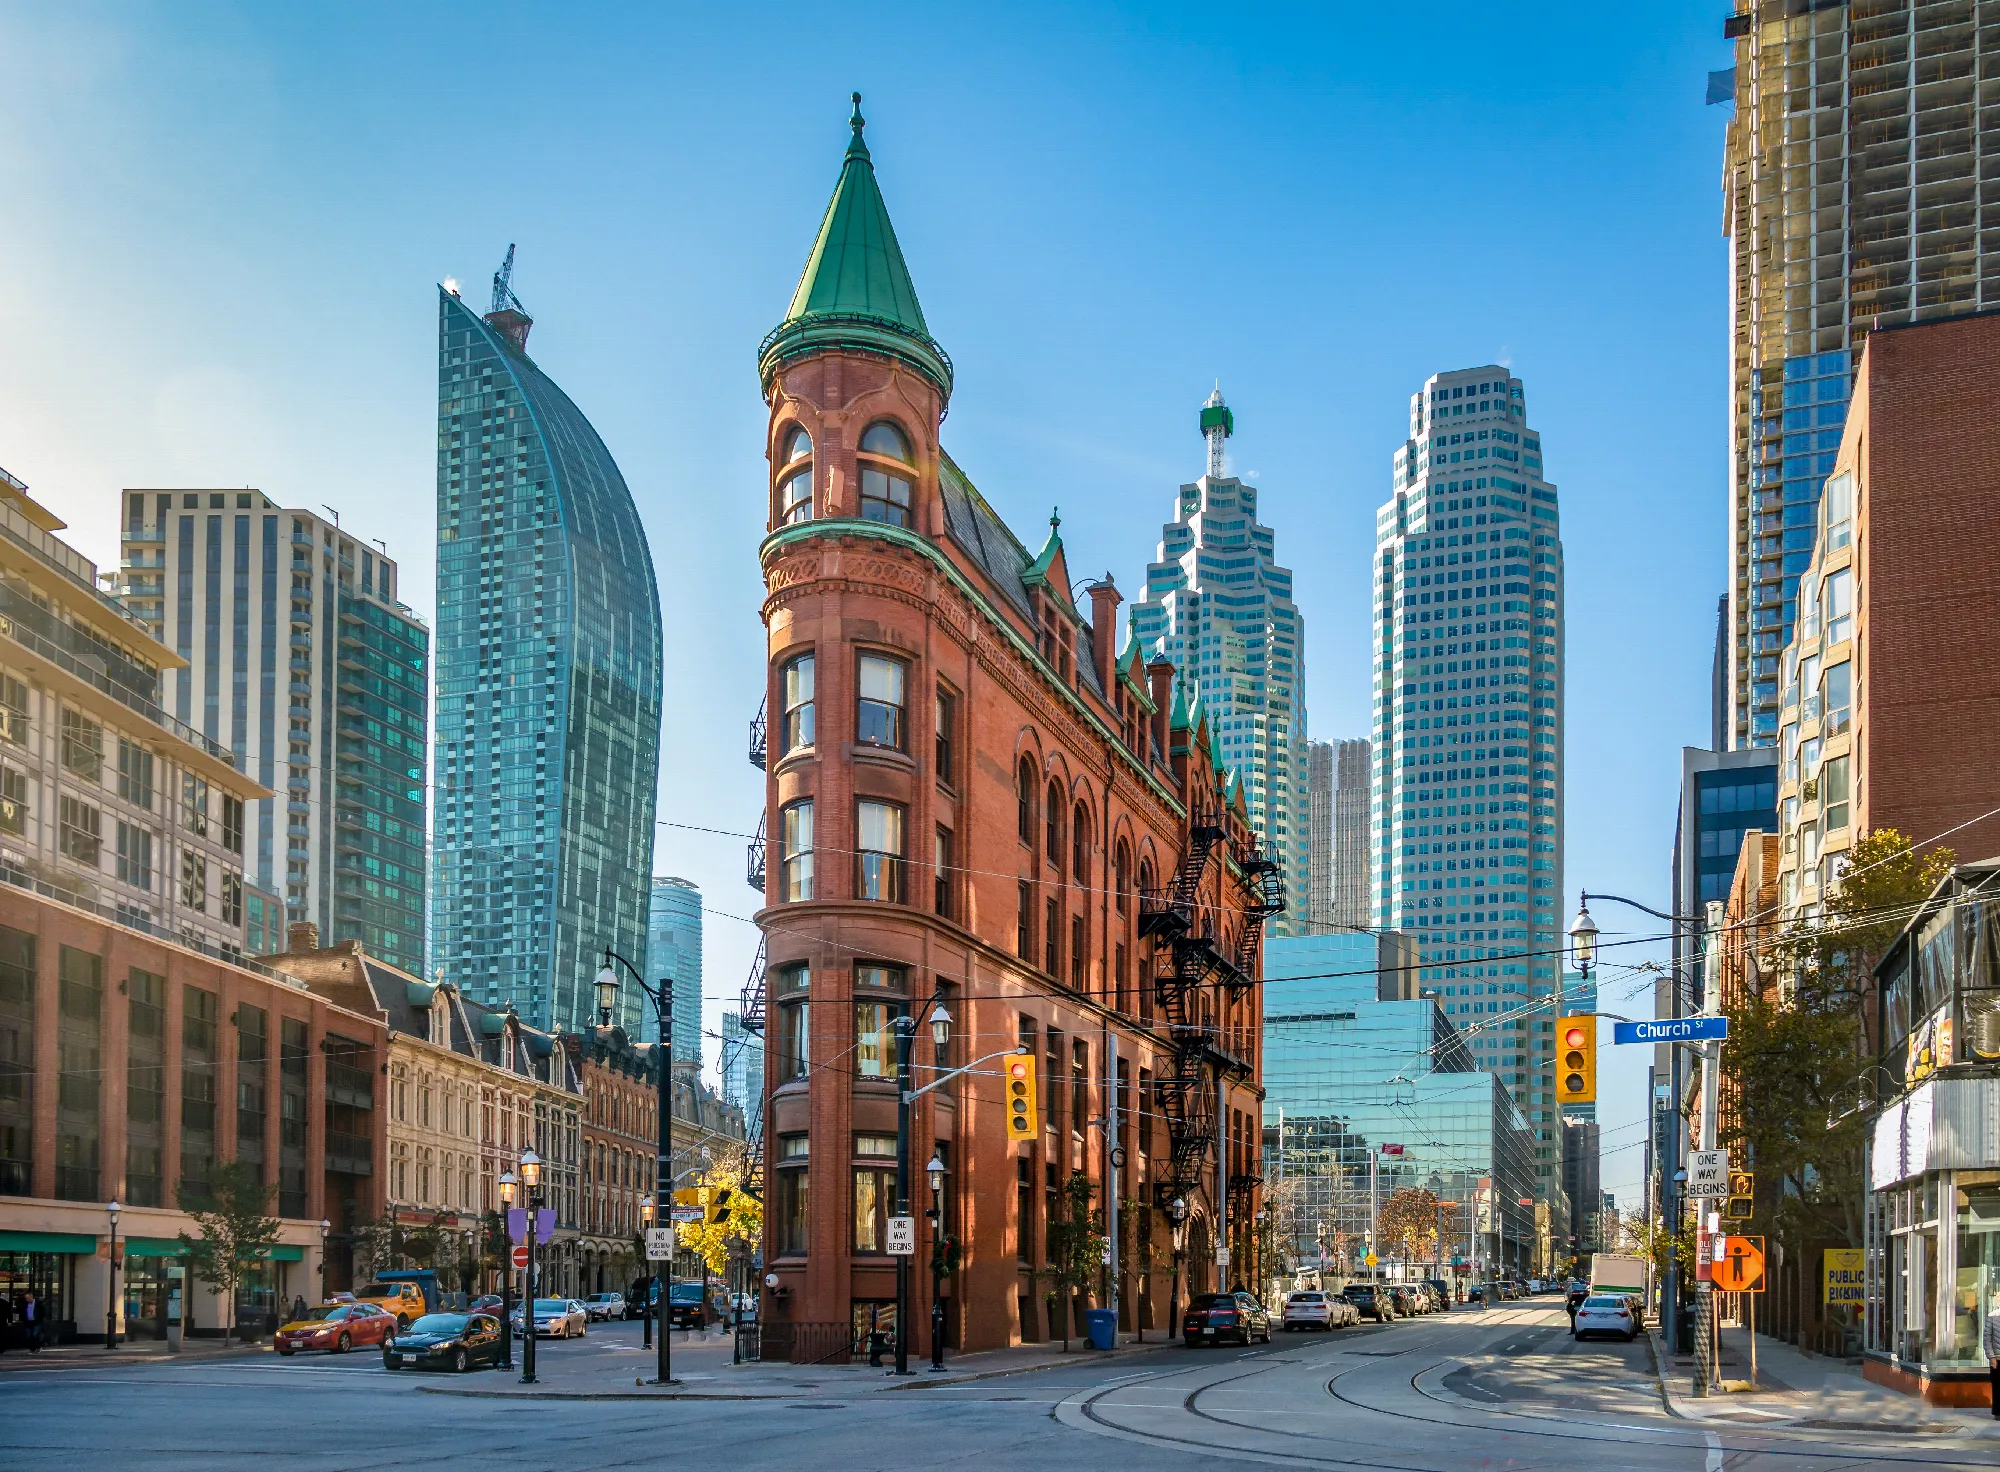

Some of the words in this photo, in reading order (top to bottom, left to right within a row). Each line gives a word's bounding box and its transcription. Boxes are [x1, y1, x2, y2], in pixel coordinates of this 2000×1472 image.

[1636, 1022, 1690, 1038] Church
[1695, 1020, 1704, 1028] St
[1697, 1154, 1718, 1165] ONE
[1697, 1169, 1718, 1179] WAY
[1690, 1183, 1726, 1195] BEGINS
[655, 1231, 665, 1240] NO
[893, 1232, 907, 1240] WAY
[889, 1243, 913, 1251] BEGINS
[1829, 1270, 1864, 1283] PUBLIC
